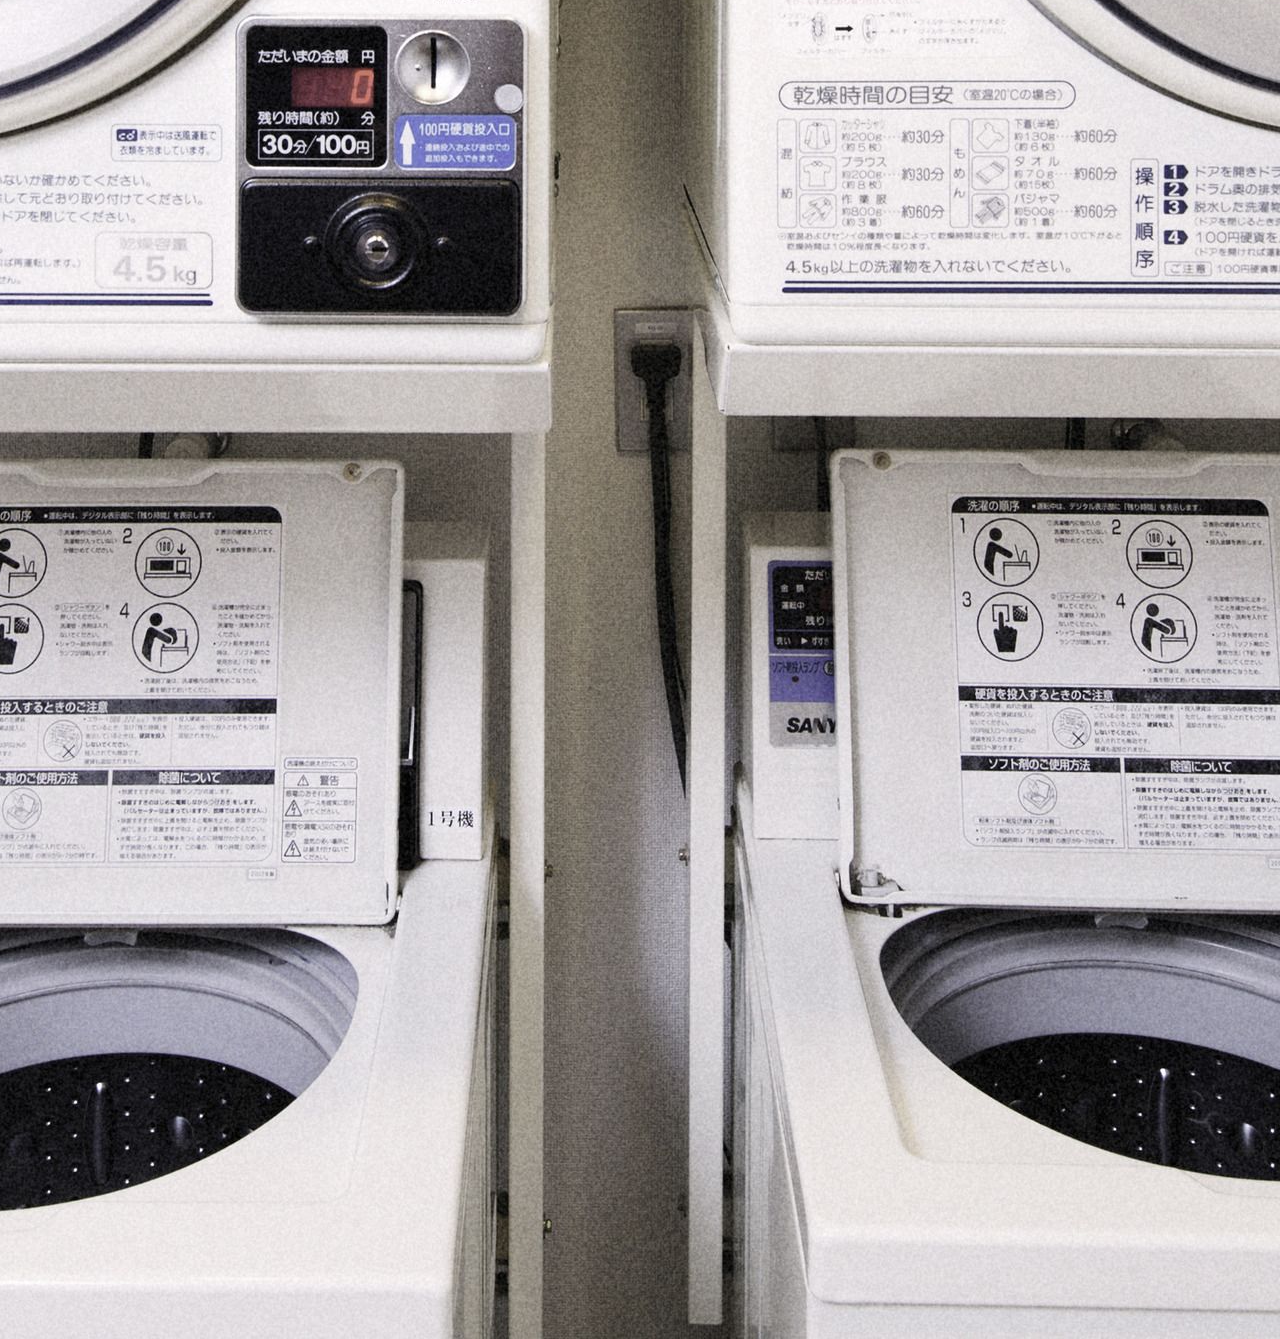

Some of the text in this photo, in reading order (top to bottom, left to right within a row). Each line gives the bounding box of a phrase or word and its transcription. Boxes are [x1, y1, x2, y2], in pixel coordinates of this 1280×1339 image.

[257, 49, 375, 64] ただいまの金額 円
[793, 84, 954, 106] 乾燥時間の目安
[361, 111, 375, 125] 分
[418, 122, 510, 137] 100円硬貨投入口
[901, 129, 945, 144] 約30分
[1073, 128, 1118, 144] 約60分
[261, 134, 370, 156] 30分/100円
[841, 156, 887, 168] ブラウス
[901, 167, 945, 182] 約30分
[1073, 166, 1118, 181] 約60分
[1170, 165, 1178, 178] 1
[1168, 182, 1180, 196] 2
[1014, 193, 1060, 205] パジャマ
[901, 204, 945, 219] 約60分
[1073, 204, 1118, 219] 約60分
[1168, 200, 1180, 214] 3
[1135, 166, 1155, 269] 操作順序
[1167, 231, 1181, 245] 4
[112, 254, 198, 286] 4.5 kg
[785, 260, 1074, 276] 4.5kg以上の洗濯物を入れないでください。
[966, 499, 1021, 512] 洗濯の順序
[1112, 519, 1122, 536] 2
[123, 528, 133, 544] 2
[962, 591, 972, 608] 3
[1116, 593, 1127, 610] 4
[119, 602, 130, 619] 4
[974, 687, 1115, 702] 硬貨を投入するときのご注意
[987, 757, 1092, 771] ソフト剤のご使用方法
[1170, 760, 1233, 773] 除菌について
[158, 771, 222, 784] 除菌について
[428, 810, 475, 828] 1号機
